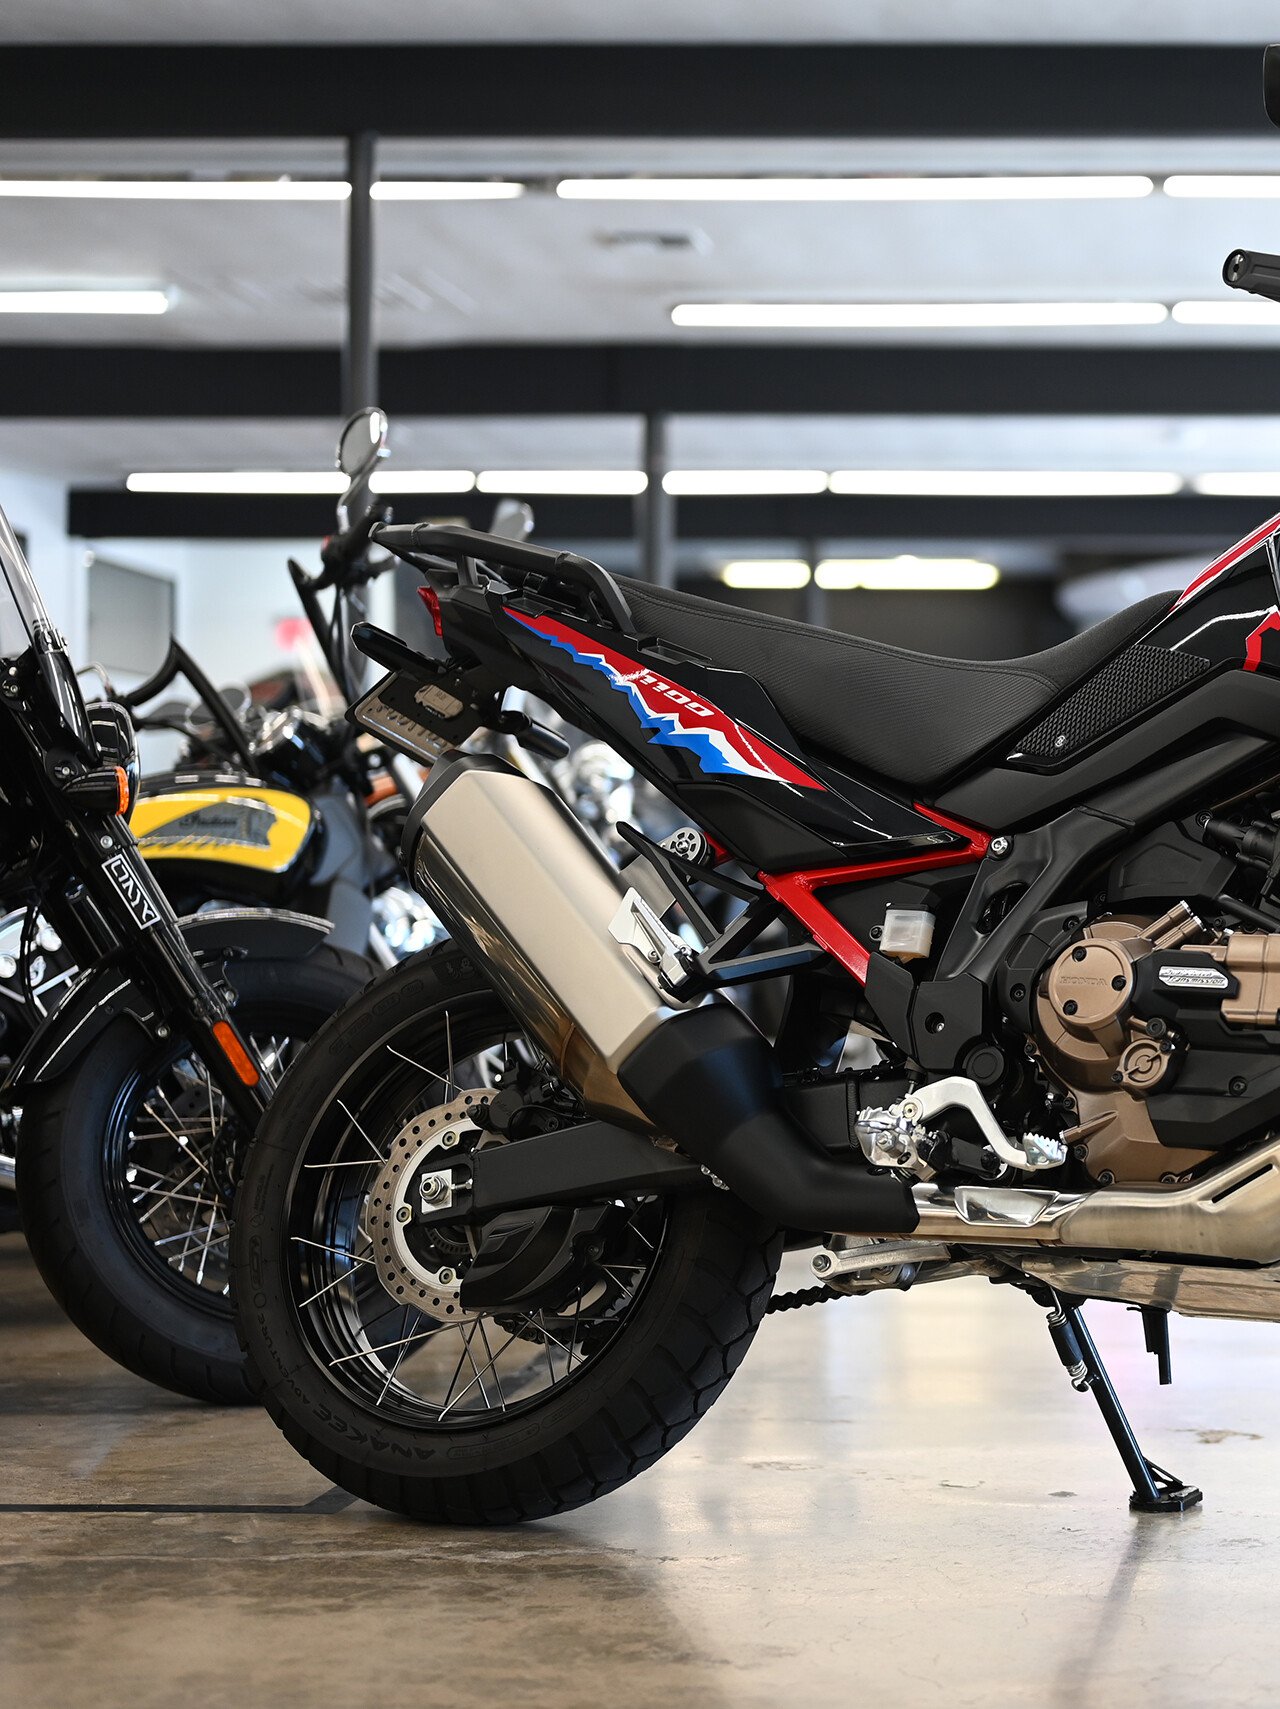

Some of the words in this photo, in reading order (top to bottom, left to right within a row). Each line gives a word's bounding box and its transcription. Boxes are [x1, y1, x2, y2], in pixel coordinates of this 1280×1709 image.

[639, 674, 715, 717] 1100
[1060, 976, 1108, 986] HONDA
[311, 1402, 437, 1462] ANAKEE
